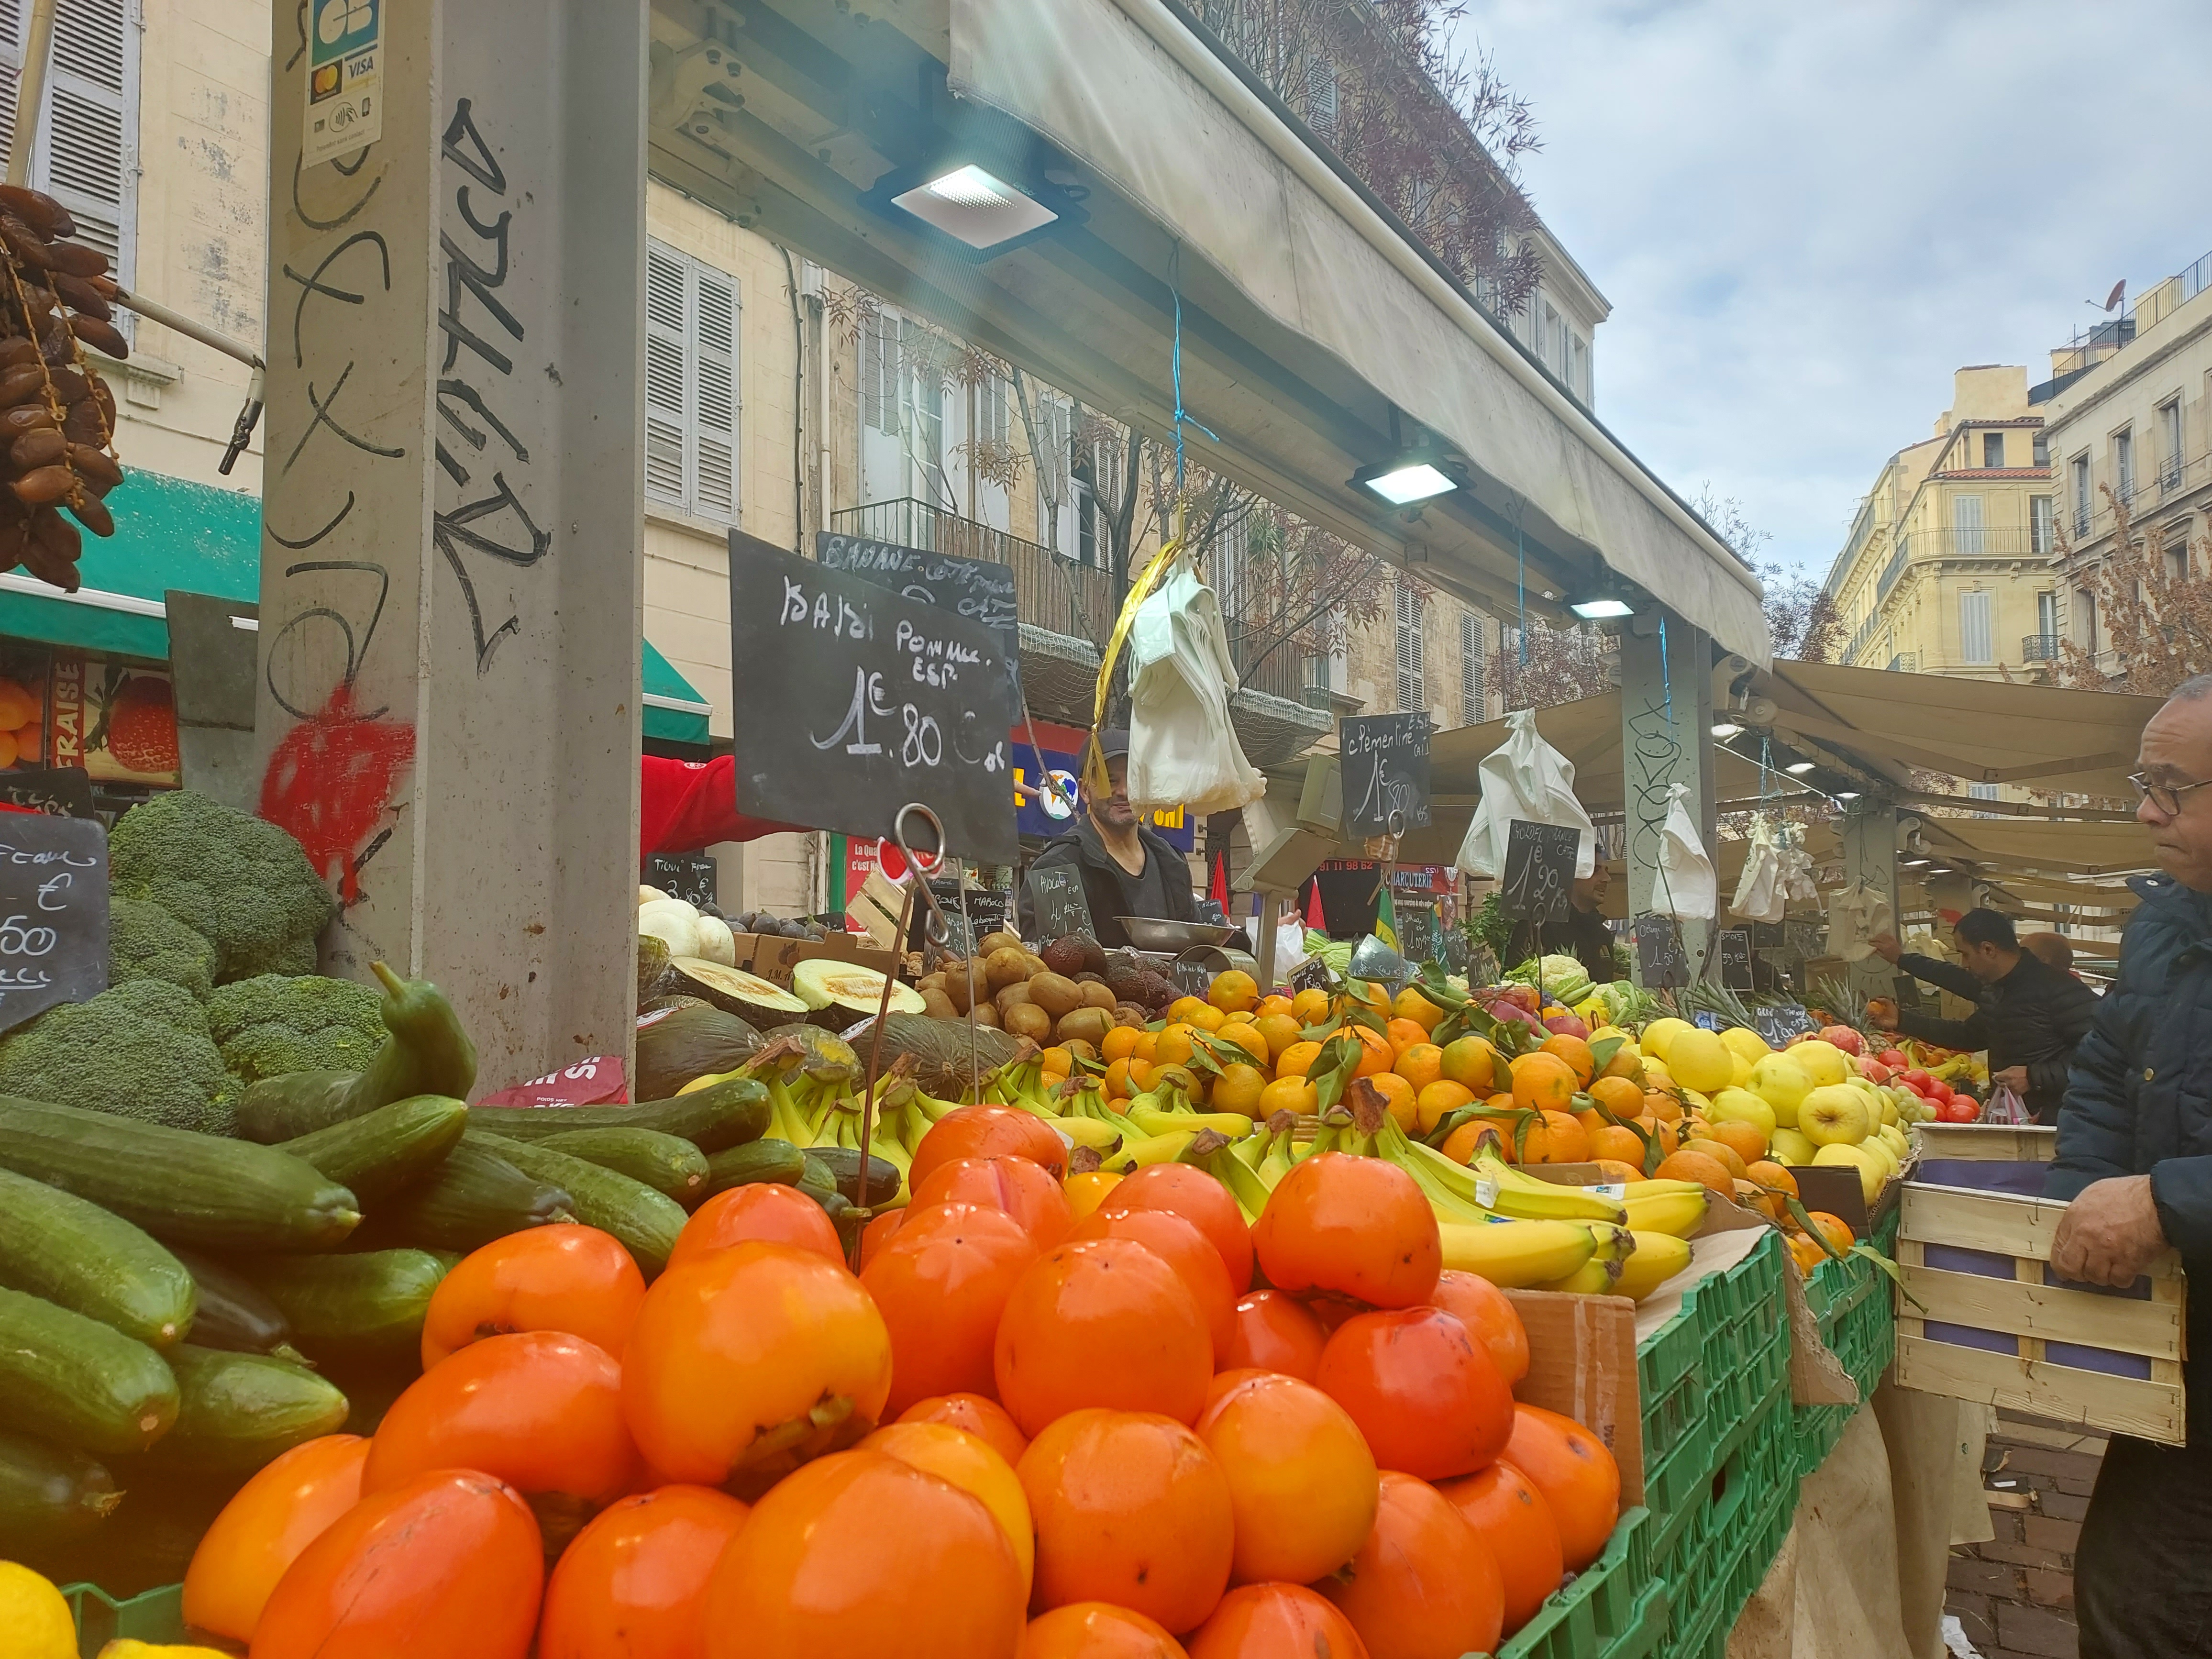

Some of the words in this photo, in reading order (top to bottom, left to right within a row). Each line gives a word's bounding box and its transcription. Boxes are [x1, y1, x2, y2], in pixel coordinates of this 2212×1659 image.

[348, 56, 373, 78] VISA
[55, 662, 80, 768] FRAISE
[854, 843, 862, 855] La
[864, 844, 877, 857] Qua
[1346, 862, 1358, 870] 98
